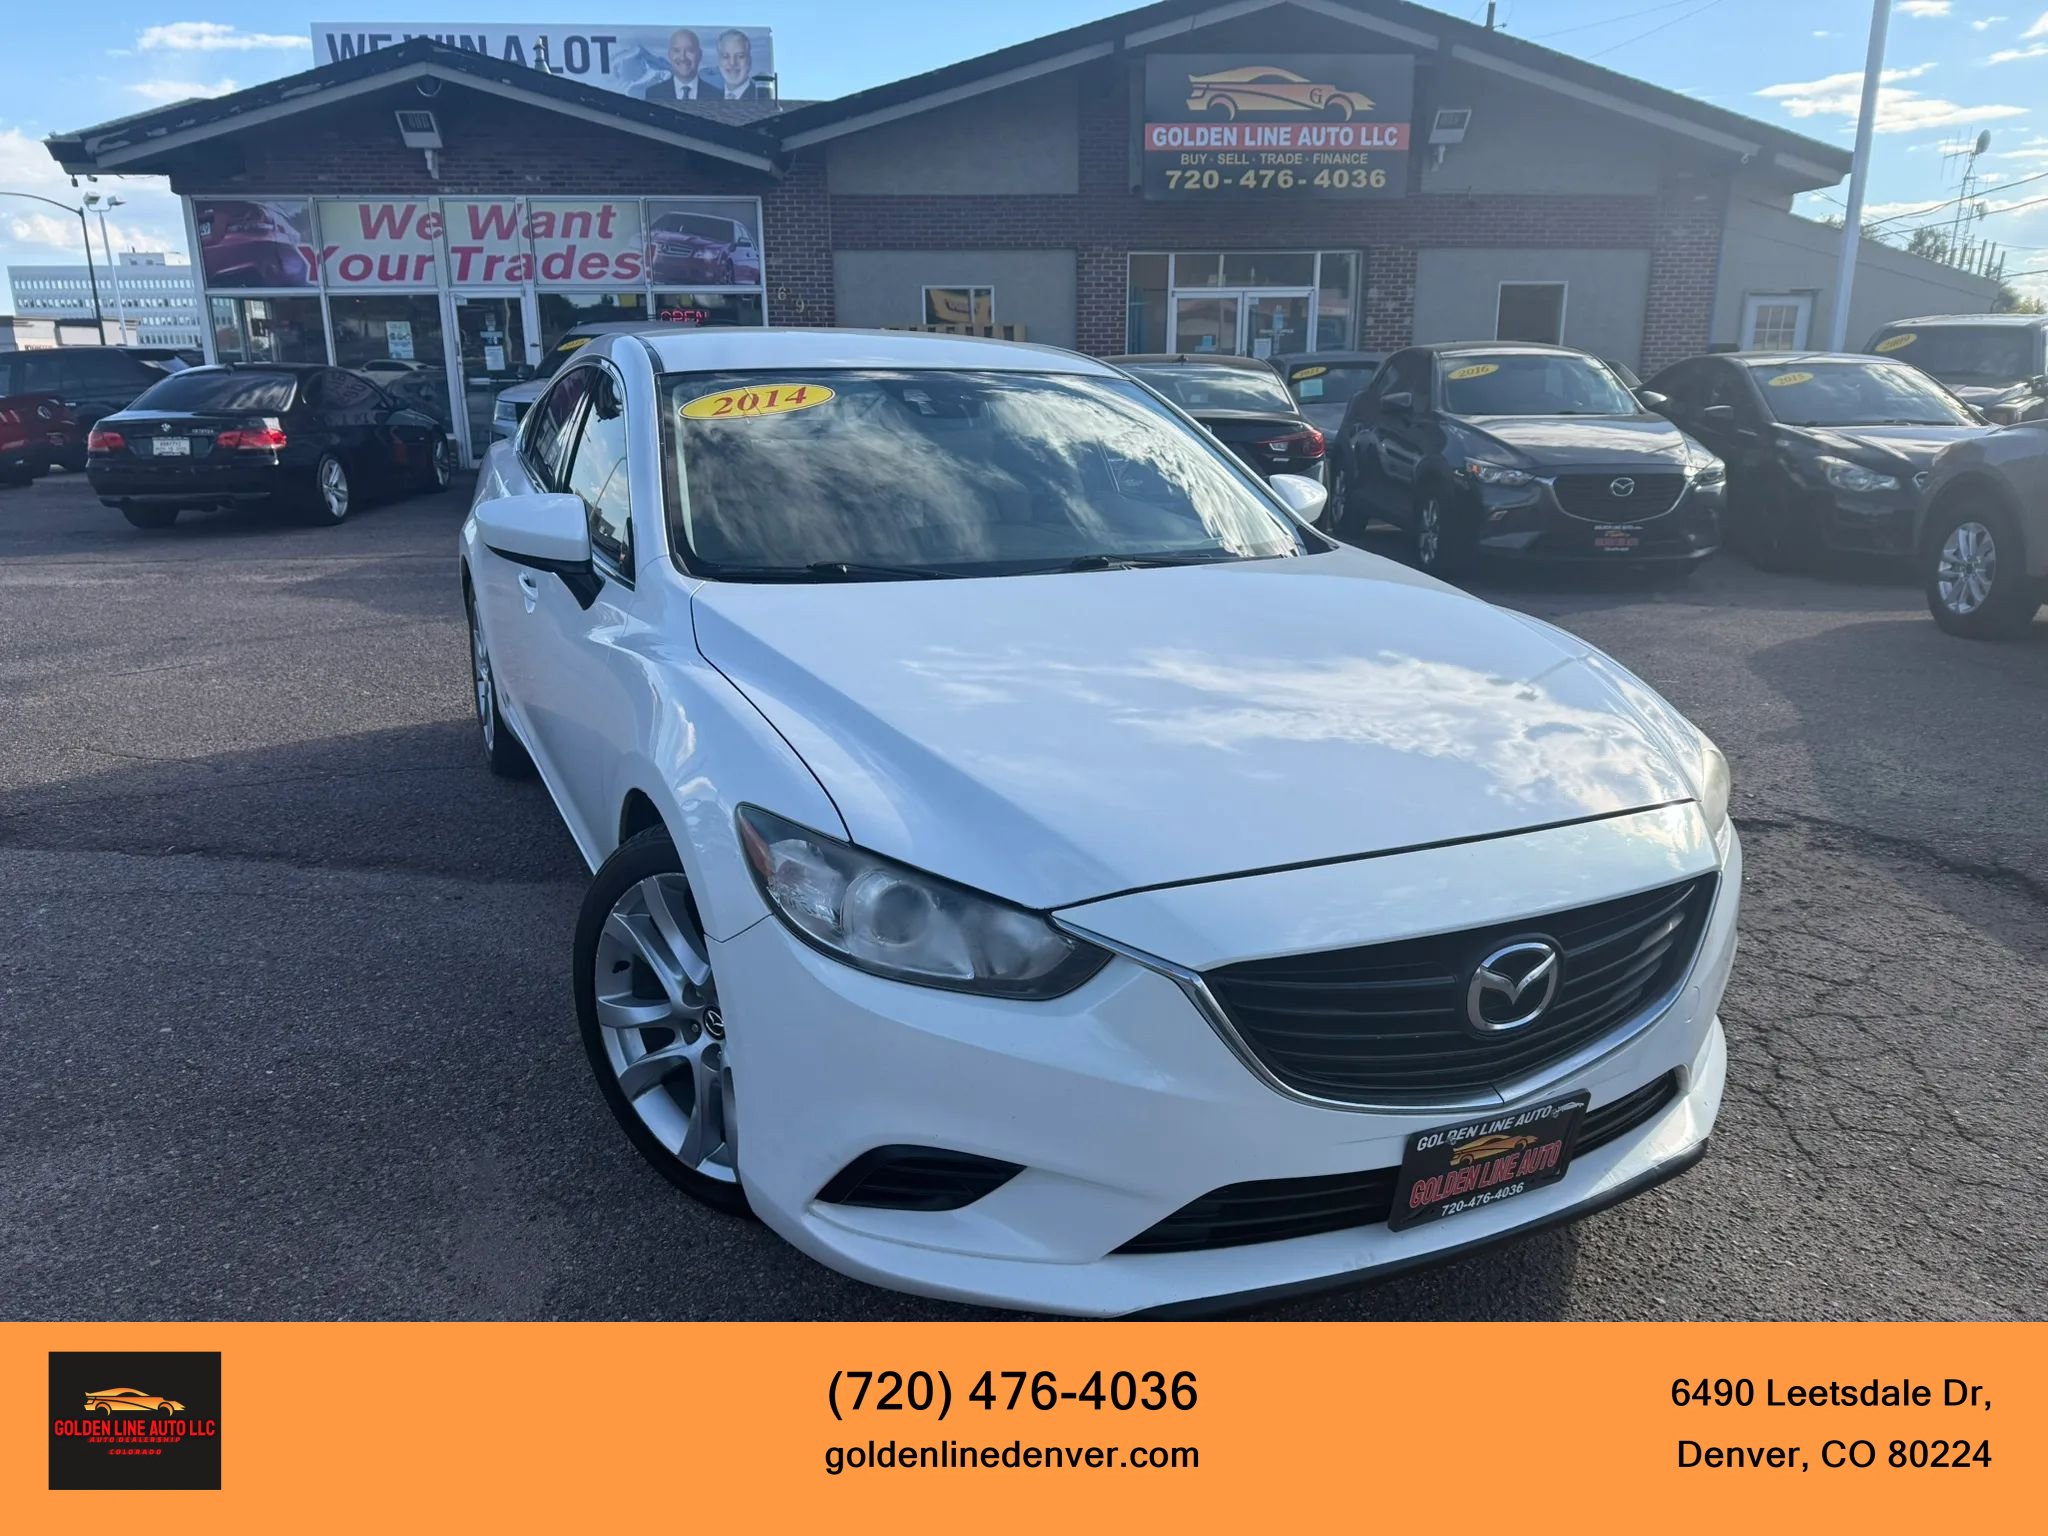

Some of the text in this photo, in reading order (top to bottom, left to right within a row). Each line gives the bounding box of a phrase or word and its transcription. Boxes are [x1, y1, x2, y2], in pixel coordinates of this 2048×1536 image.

[539, 35, 617, 75] LOT
[1152, 126, 1398, 147] GOLDEN LINE AUTO LLC
[1181, 152, 1368, 165] BUY SELL TRADE FINANCE
[358, 202, 617, 241] We Want
[298, 243, 658, 283] Your Trades!
[660, 310, 708, 323] OPEN
[1458, 365, 1490, 378] 2016
[711, 386, 808, 417] 2014
[1416, 1105, 1553, 1152] GOLDEN LINE AUTO
[1409, 1139, 1563, 1209] GOLDEN LINE AUTO
[1441, 1182, 1525, 1217] 720-476-4036
